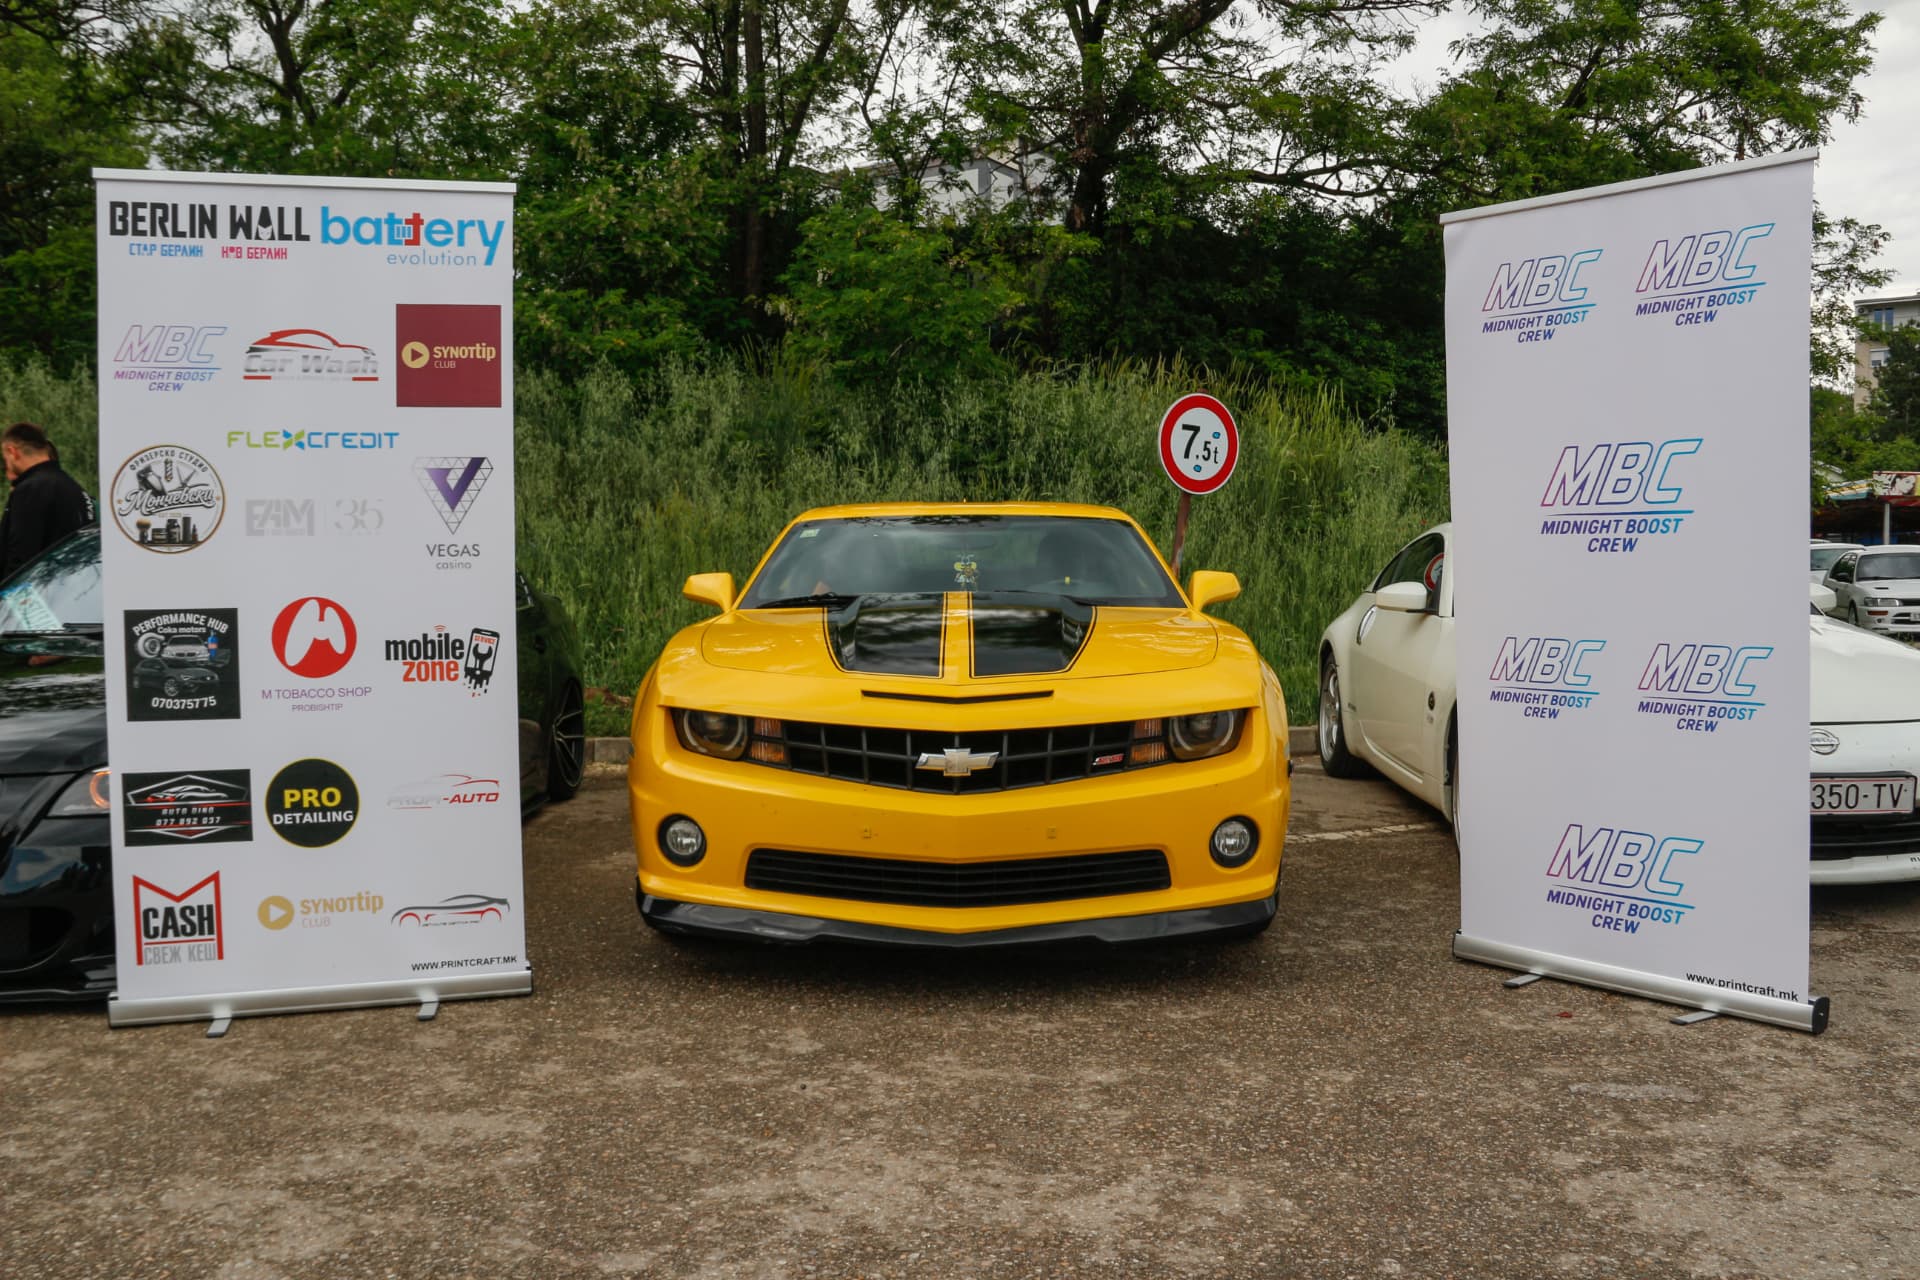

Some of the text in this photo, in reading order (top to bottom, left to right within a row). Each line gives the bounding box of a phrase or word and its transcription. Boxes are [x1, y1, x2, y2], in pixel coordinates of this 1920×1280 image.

[110, 201, 311, 242] BERLIN WALL
[320, 206, 505, 266] battery
[160, 244, 204, 258] БЕРЛИН
[246, 247, 288, 260] БЕРЛИН
[387, 249, 477, 266] evolution
[1634, 222, 1776, 293] MBC
[1482, 249, 1604, 312] MBC
[1636, 289, 1757, 316] MIDNIGHT BOOST
[1482, 310, 1589, 334] MIDNIGHT BOOST
[1674, 310, 1719, 327] CREW
[113, 324, 228, 364] MBC
[1517, 328, 1556, 343] CREW
[434, 360, 456, 369] CLUB
[114, 370, 216, 382] MIDNIGHT BOOST
[148, 382, 184, 392] CREW
[1540, 438, 1704, 507] MBC
[1541, 518, 1685, 535] MIDNIGHT BOOST
[426, 543, 481, 557] VEGAS
[1587, 537, 1639, 553] CREW
[435, 560, 472, 570] casino
[132, 612, 229, 636] PERFORMANCE HUB
[385, 632, 465, 661] mobile
[402, 660, 460, 683] zone
[1489, 636, 1607, 687] MBC
[1637, 643, 1774, 697] MBC
[151, 696, 217, 710] 070375775
[261, 686, 373, 700] M TOBACCO SHOP
[1490, 690, 1593, 709] MIDNIGHT BOOST
[1524, 706, 1560, 720] CREW
[1638, 701, 1757, 721] MIDNIGHT BOOST
[1676, 718, 1719, 733] CREW
[283, 786, 342, 809] PRO
[272, 810, 354, 825] DETAILING
[1546, 823, 1705, 897] MBC
[1546, 889, 1686, 926] MIDNIGHT BOOST
[142, 904, 215, 940] CASH
[302, 917, 331, 929] CLUB
[1591, 913, 1641, 934] CREW
[143, 943, 216, 966] СВЕЖ КЕШ
[411, 955, 518, 972] WWW.PRINTCRAFT.MK
[1686, 972, 1799, 1002] www.printcraft.mk
